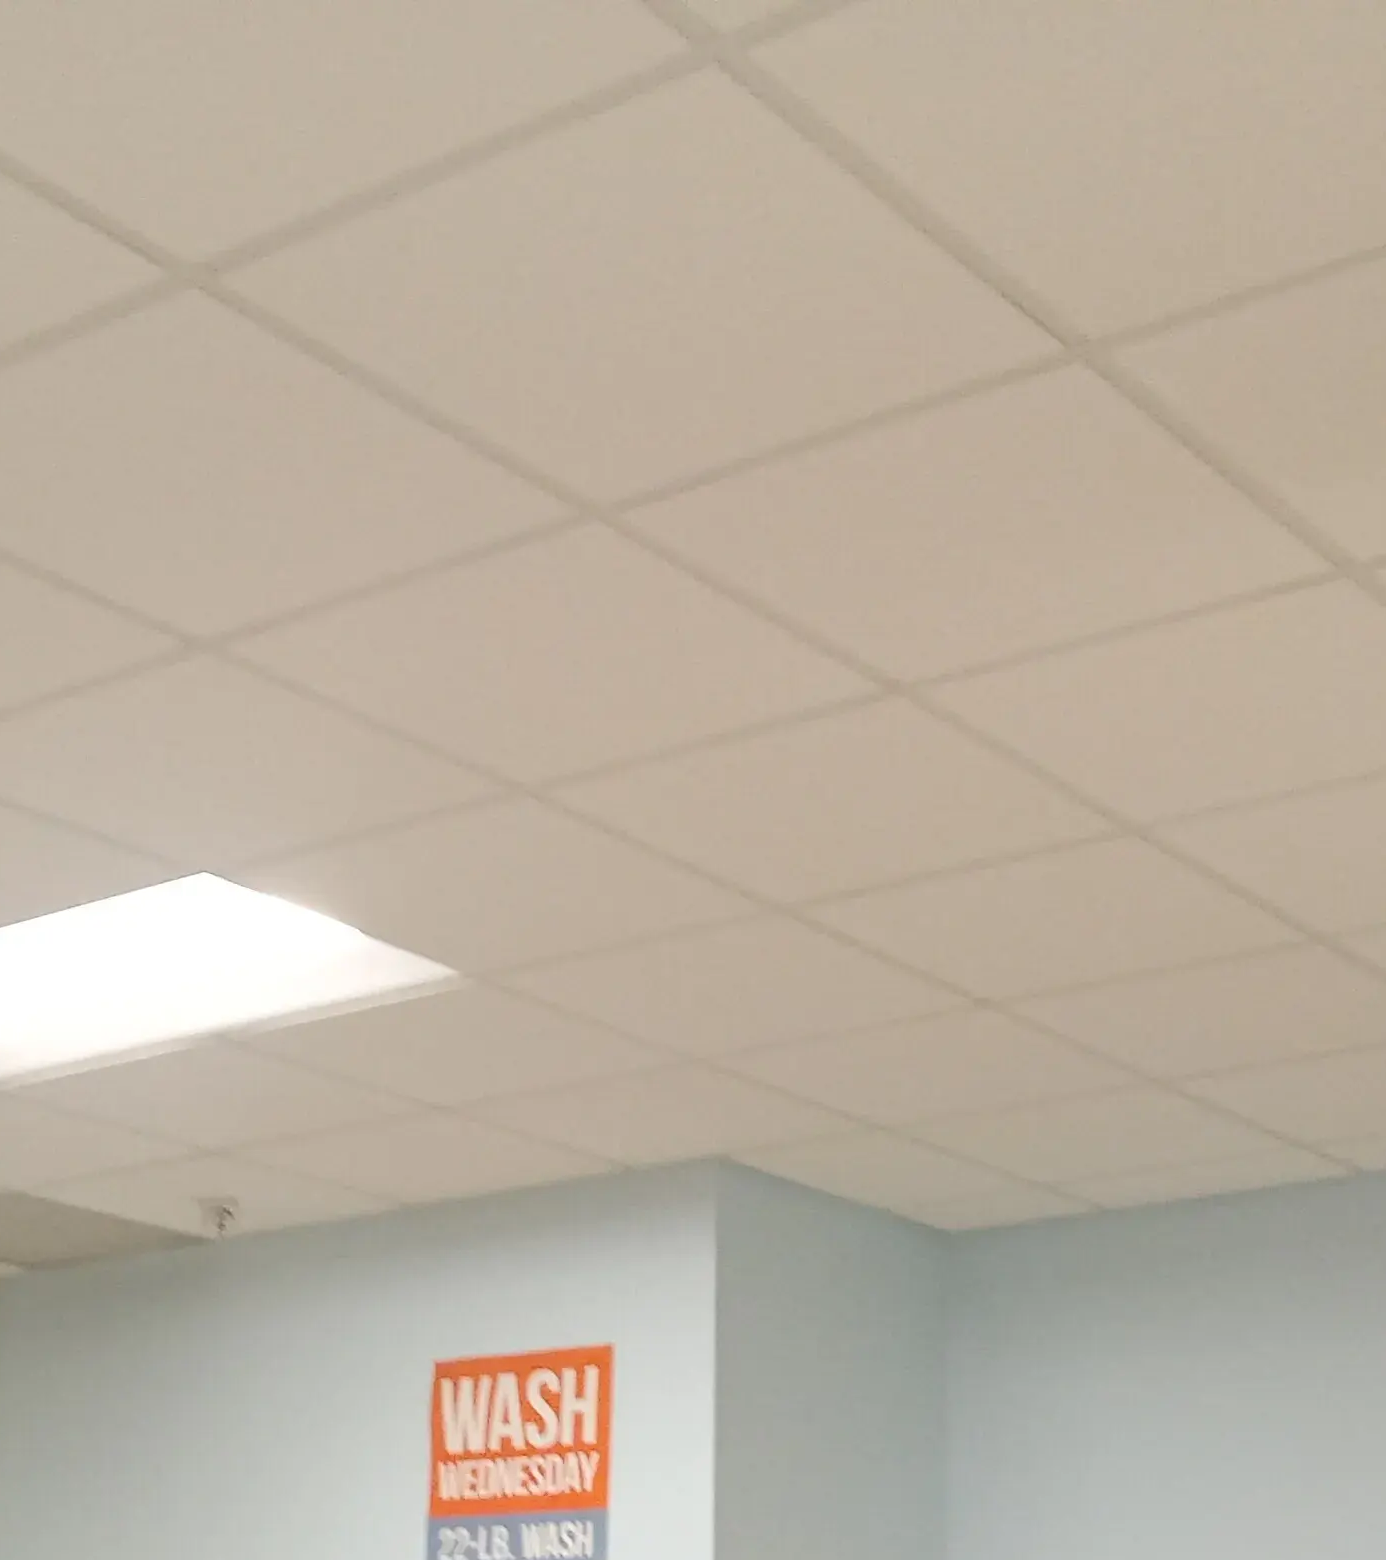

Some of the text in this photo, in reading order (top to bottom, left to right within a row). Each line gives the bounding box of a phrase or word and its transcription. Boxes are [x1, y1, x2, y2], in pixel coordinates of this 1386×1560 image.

[439, 1363, 600, 1455] WASH
[438, 1450, 600, 1500] WEDNESDAY
[521, 1519, 594, 1560] WASH
